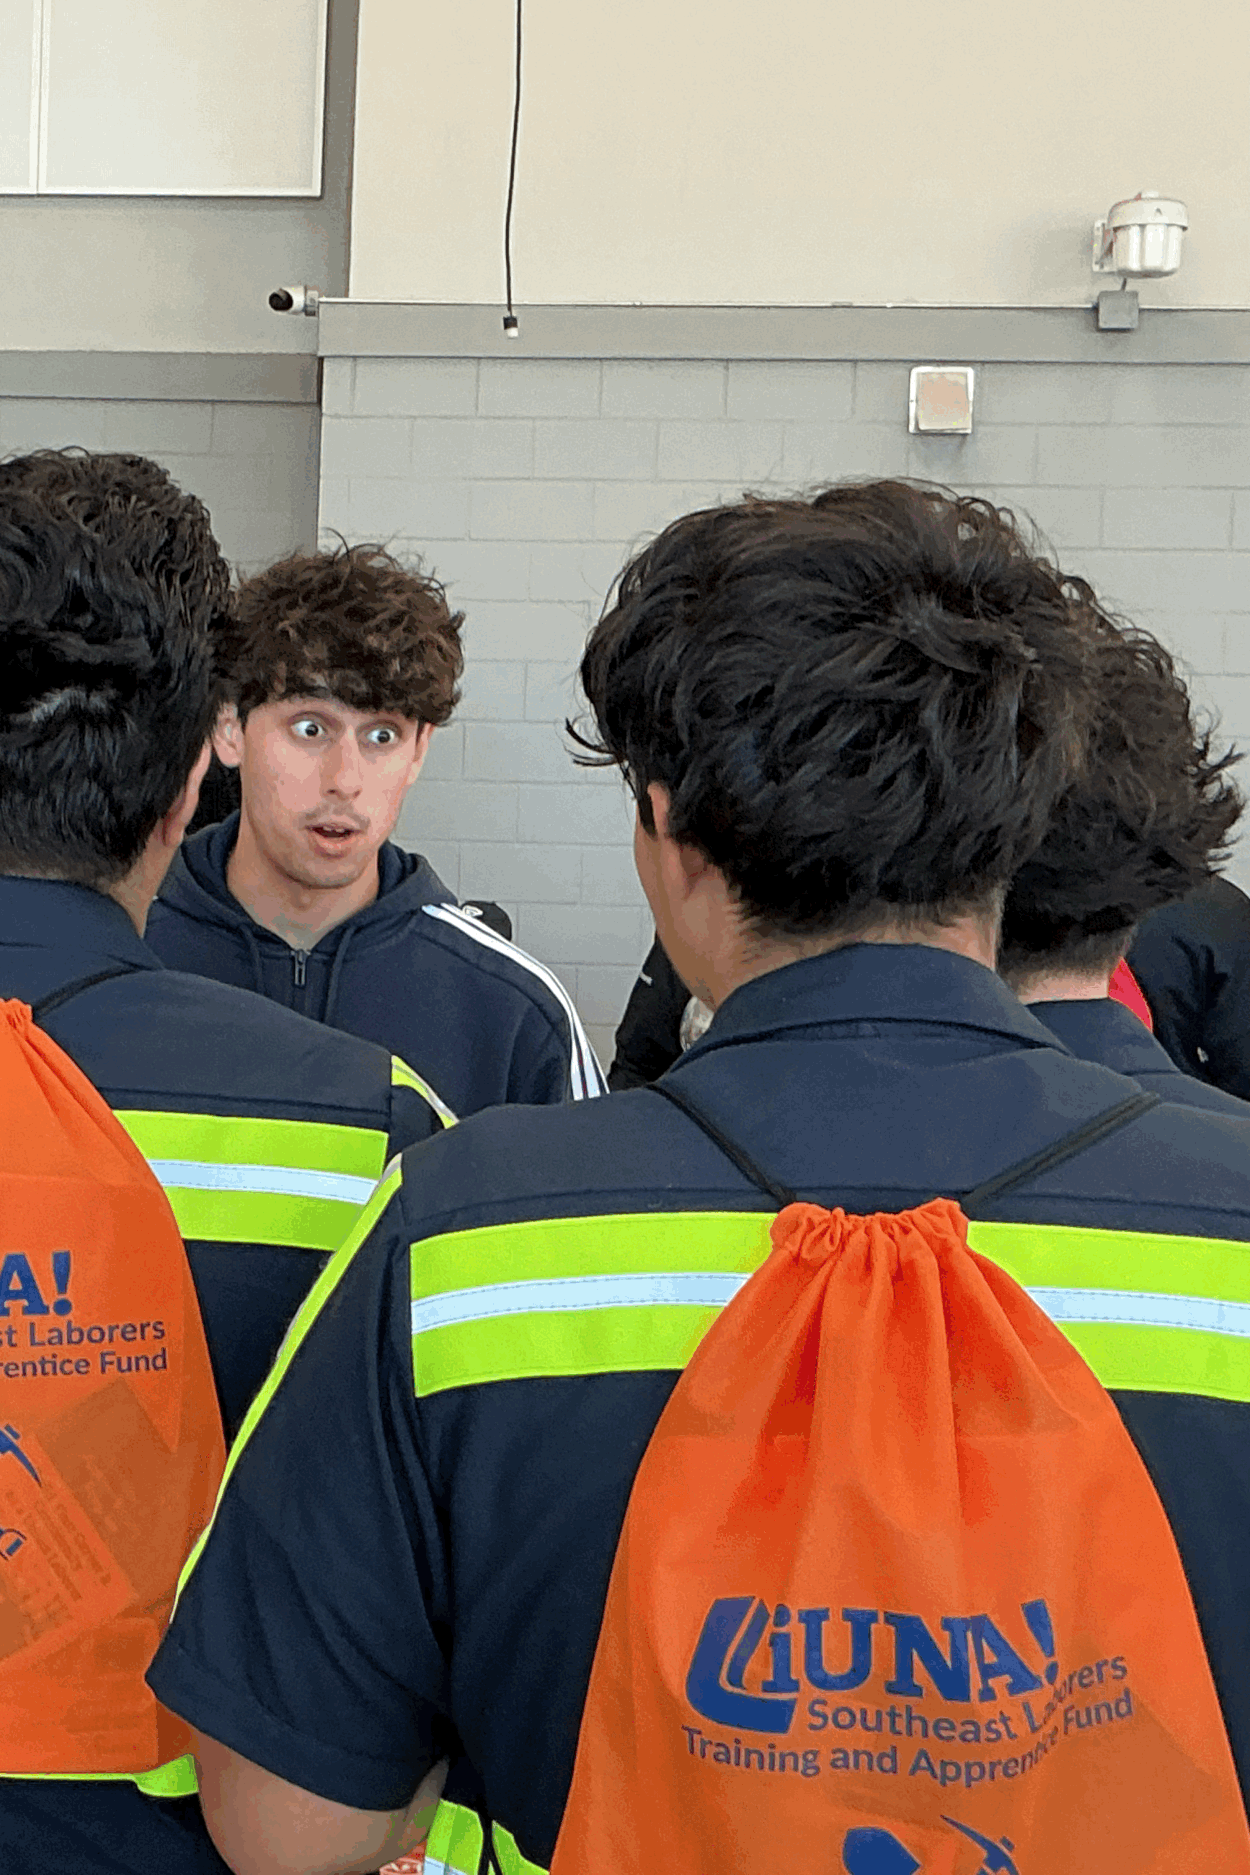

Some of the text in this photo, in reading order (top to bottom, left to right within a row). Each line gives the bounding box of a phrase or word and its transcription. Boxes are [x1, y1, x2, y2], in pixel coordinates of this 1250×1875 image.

[28, 1319, 166, 1348] Laborers
[99, 1347, 168, 1376] Fund
[681, 1723, 821, 1777] Training
[829, 1744, 899, 1775] and
[1062, 1686, 1134, 1736] Fund
[807, 1698, 1018, 1744] Southeast
